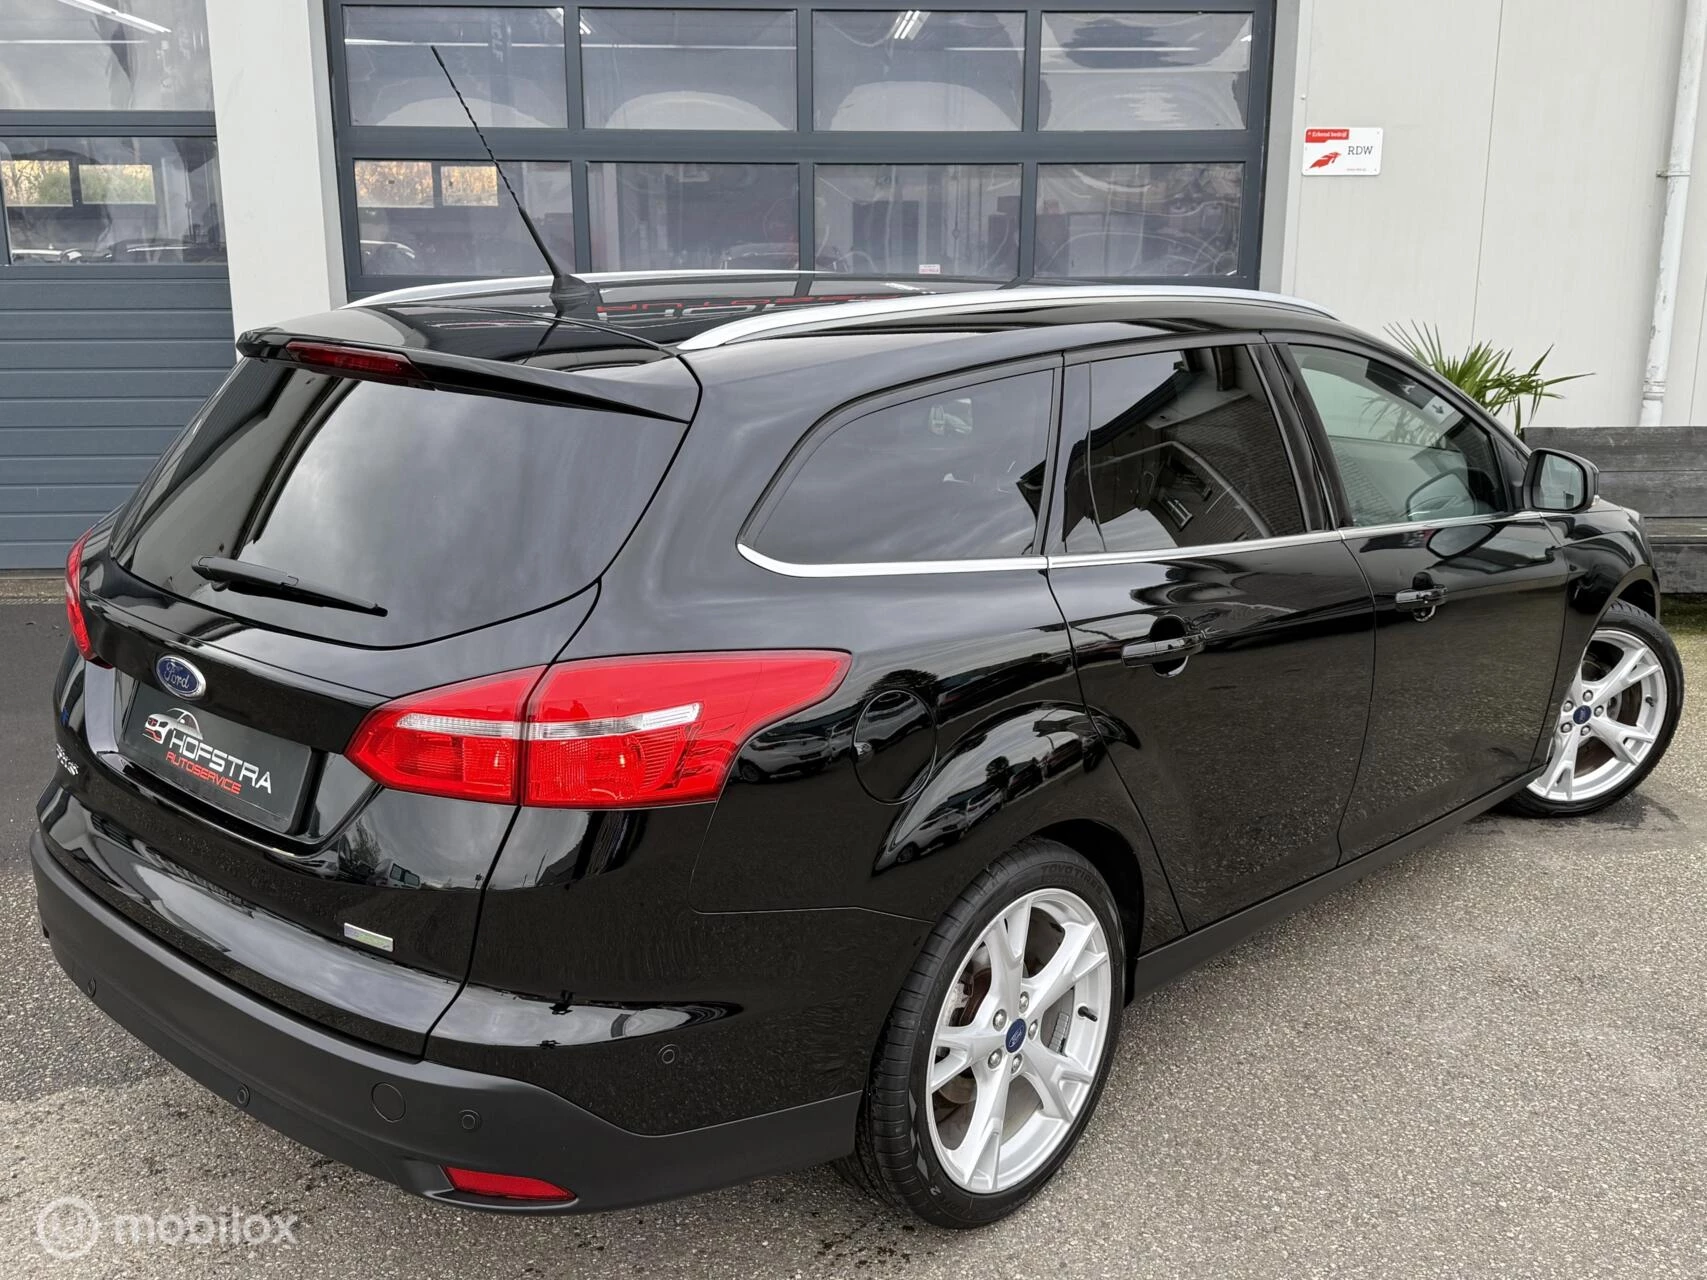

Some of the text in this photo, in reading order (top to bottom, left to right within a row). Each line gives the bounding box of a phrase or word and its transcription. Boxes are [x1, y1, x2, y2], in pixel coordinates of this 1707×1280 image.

[1347, 146, 1373, 156] RDW
[163, 662, 190, 689] Ford
[166, 751, 242, 794] AUTOSERVICE
[169, 729, 272, 794] HOFSTRA
